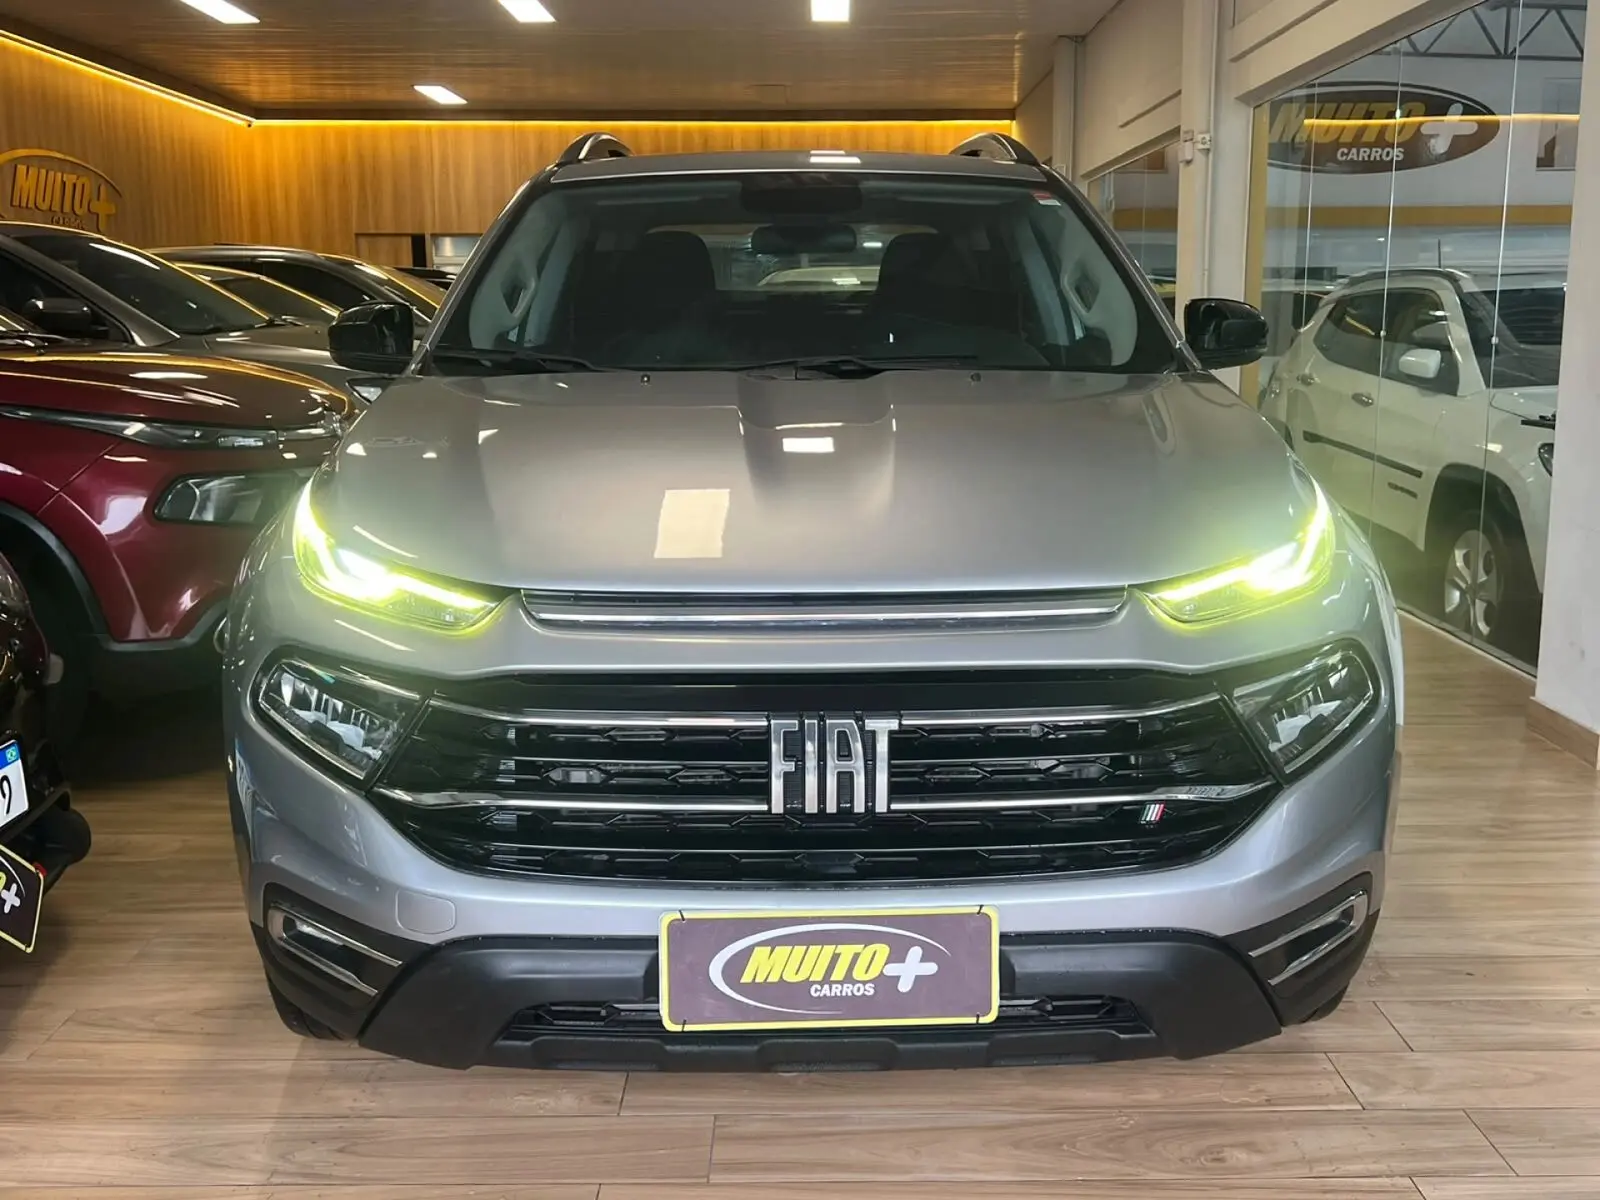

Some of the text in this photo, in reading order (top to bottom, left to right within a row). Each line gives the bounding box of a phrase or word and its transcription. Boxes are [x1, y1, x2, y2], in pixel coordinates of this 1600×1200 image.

[1336, 147, 1405, 161] CARROS
[770, 719, 900, 814] FIAT
[809, 983, 876, 997] CARROS
